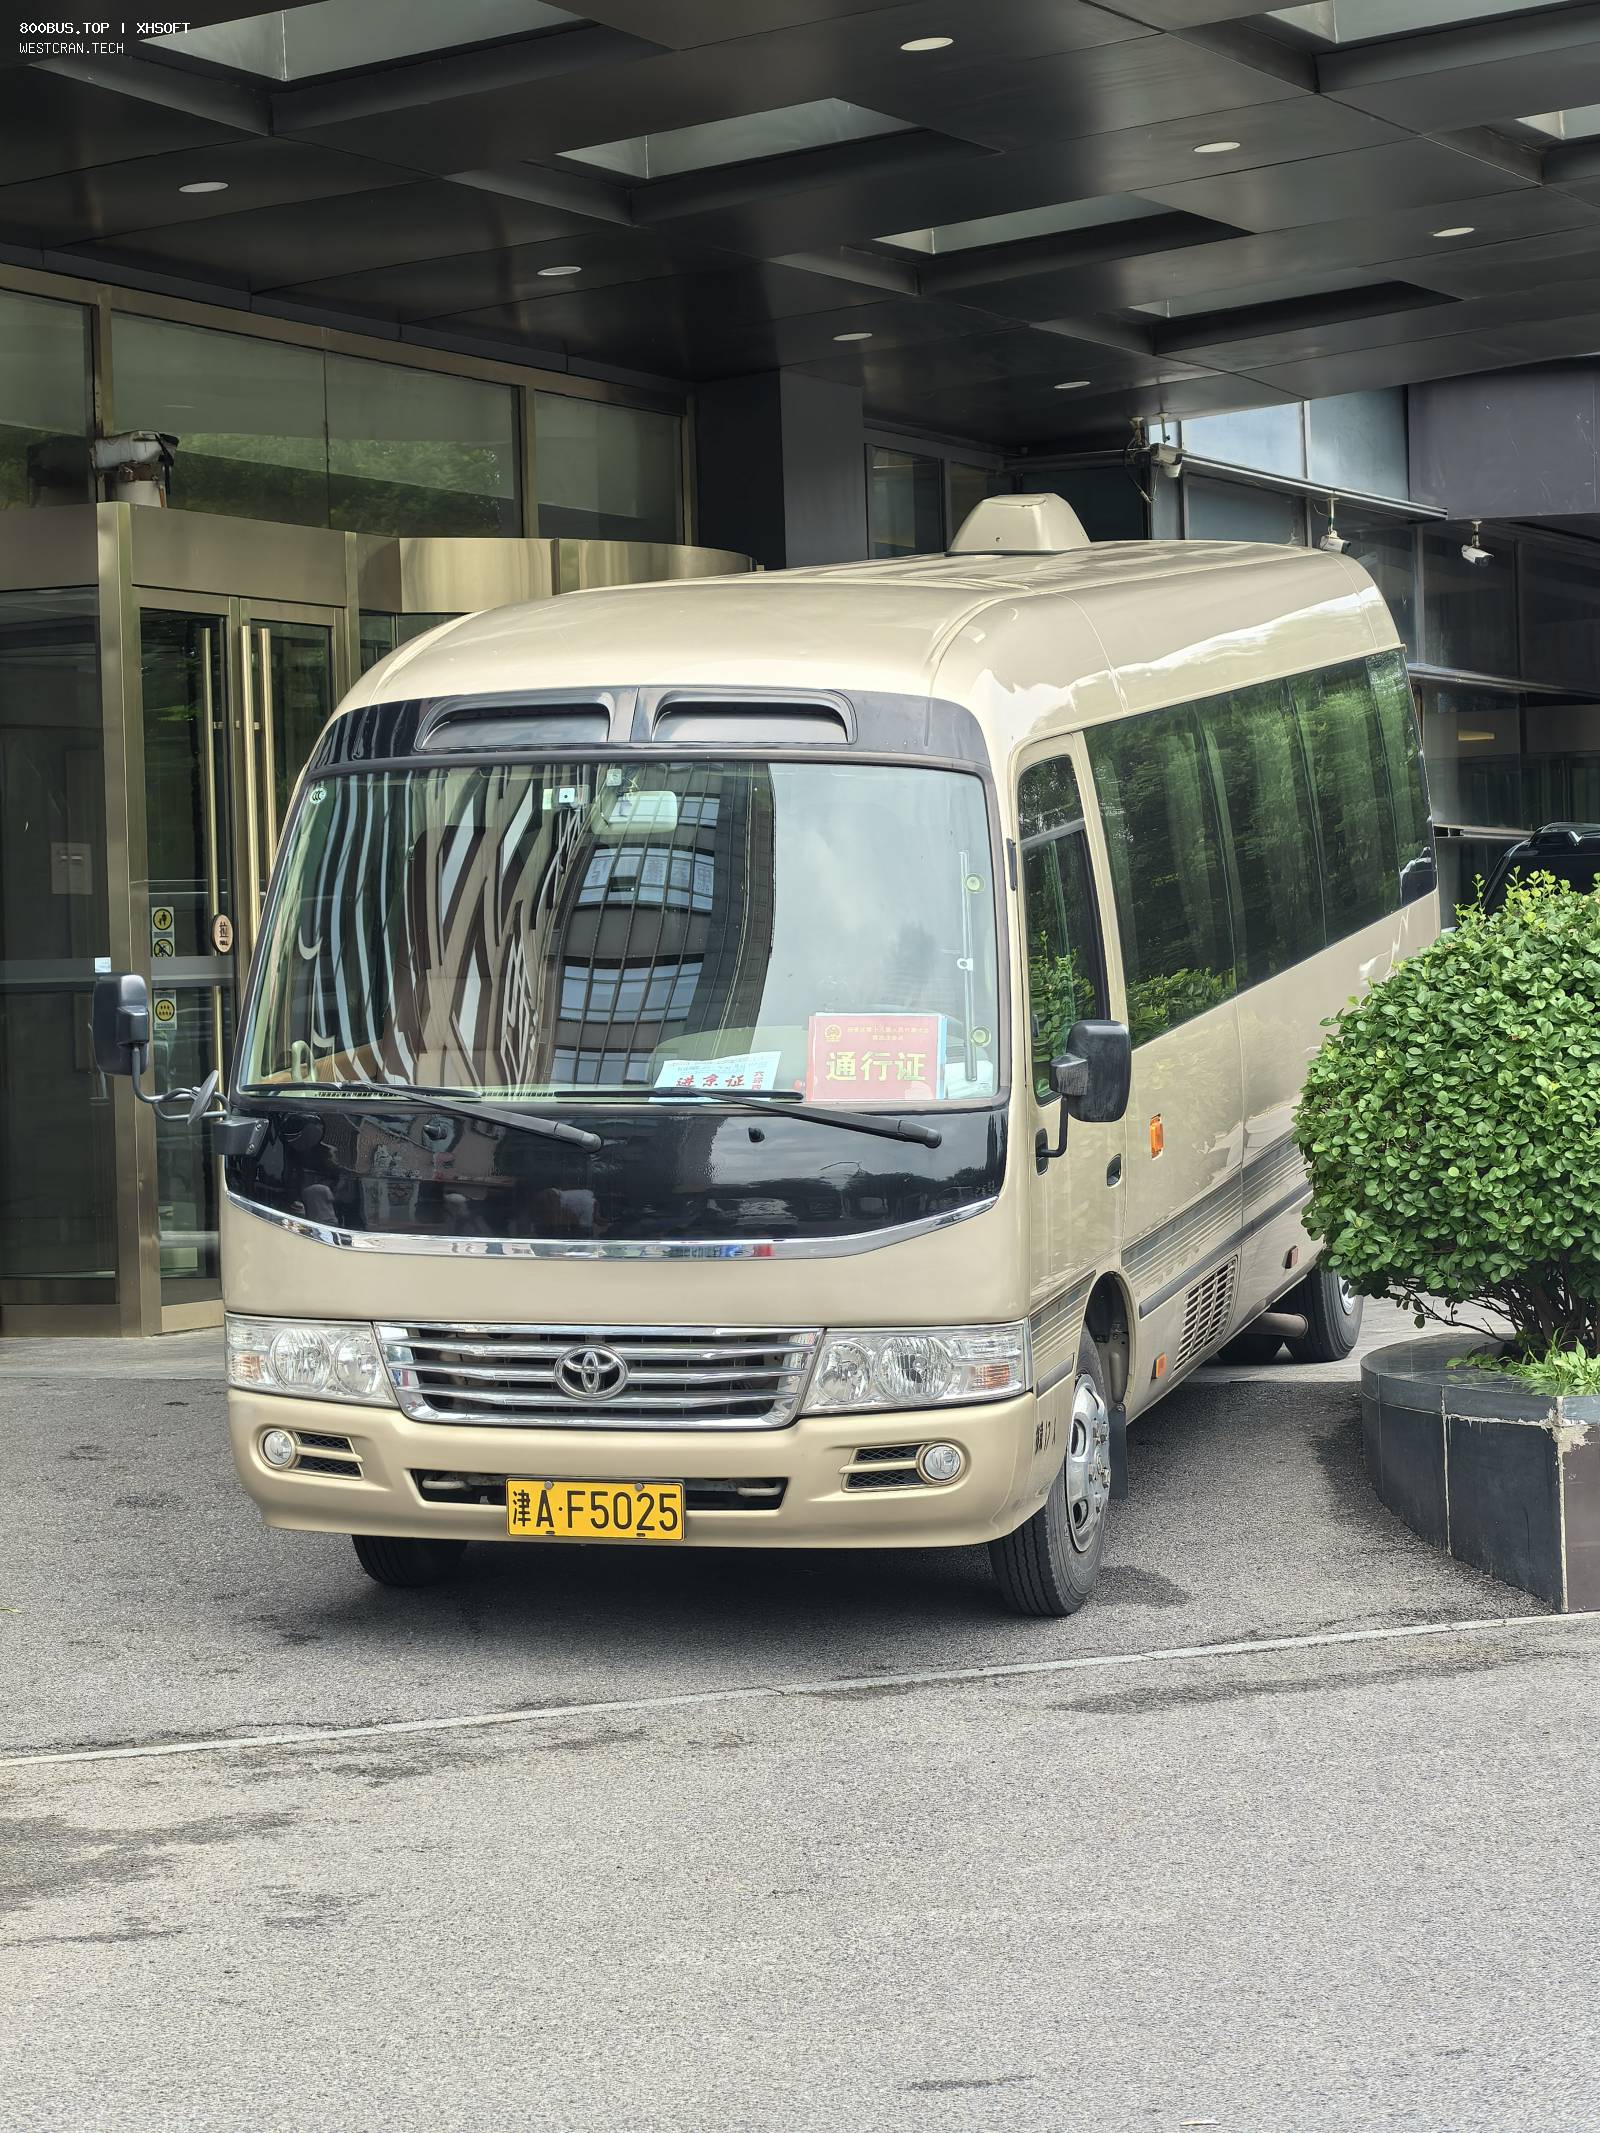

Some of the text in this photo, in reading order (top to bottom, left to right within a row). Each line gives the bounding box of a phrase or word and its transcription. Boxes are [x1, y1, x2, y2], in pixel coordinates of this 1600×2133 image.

[219, 921, 229, 938] 拉
[825, 1051, 927, 1082] 通行证
[675, 1073, 745, 1088] 进京证
[512, 1489, 678, 1531] 津A·F5025
